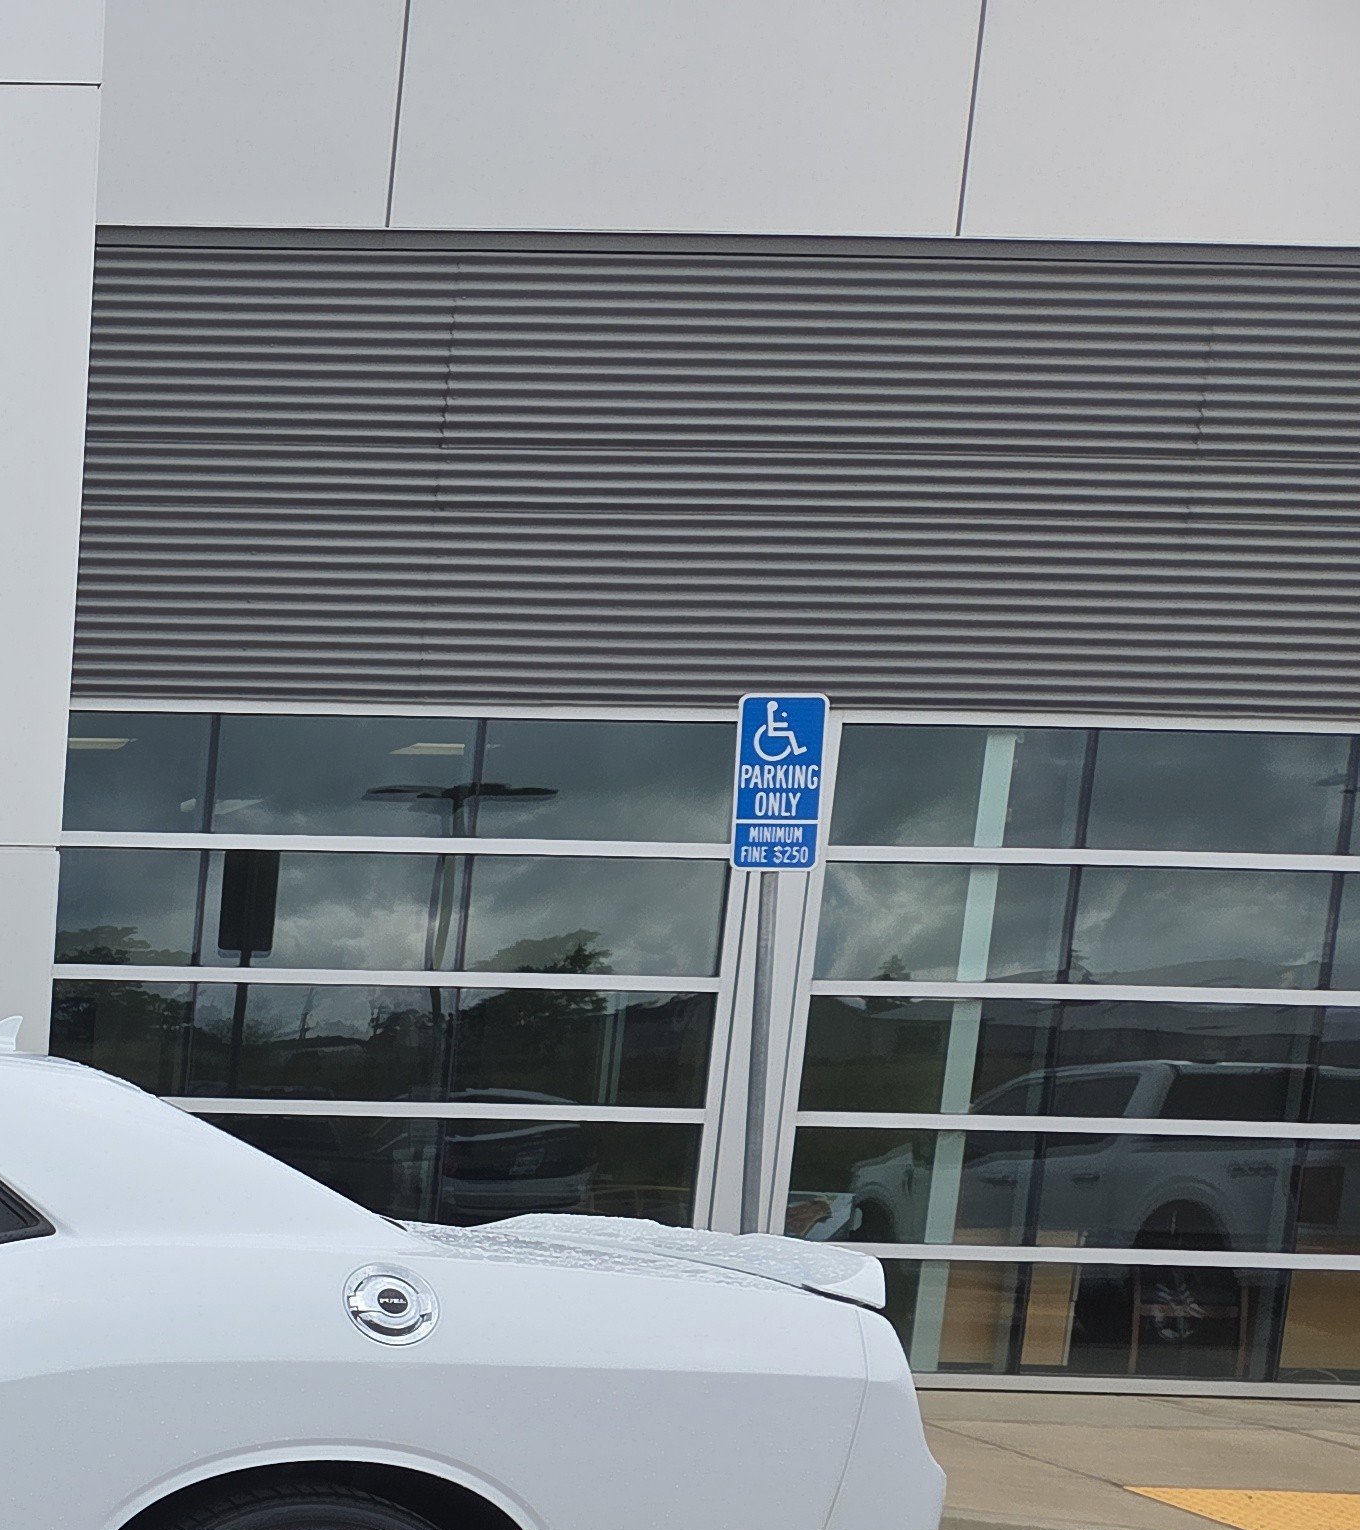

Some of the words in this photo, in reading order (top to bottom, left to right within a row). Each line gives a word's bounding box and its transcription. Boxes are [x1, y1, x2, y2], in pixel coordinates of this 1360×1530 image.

[740, 764, 819, 790] PARKING
[754, 791, 802, 817] ONLY
[748, 826, 803, 844] MINIMUM
[740, 846, 768, 863] FINE
[773, 845, 809, 864] $250
